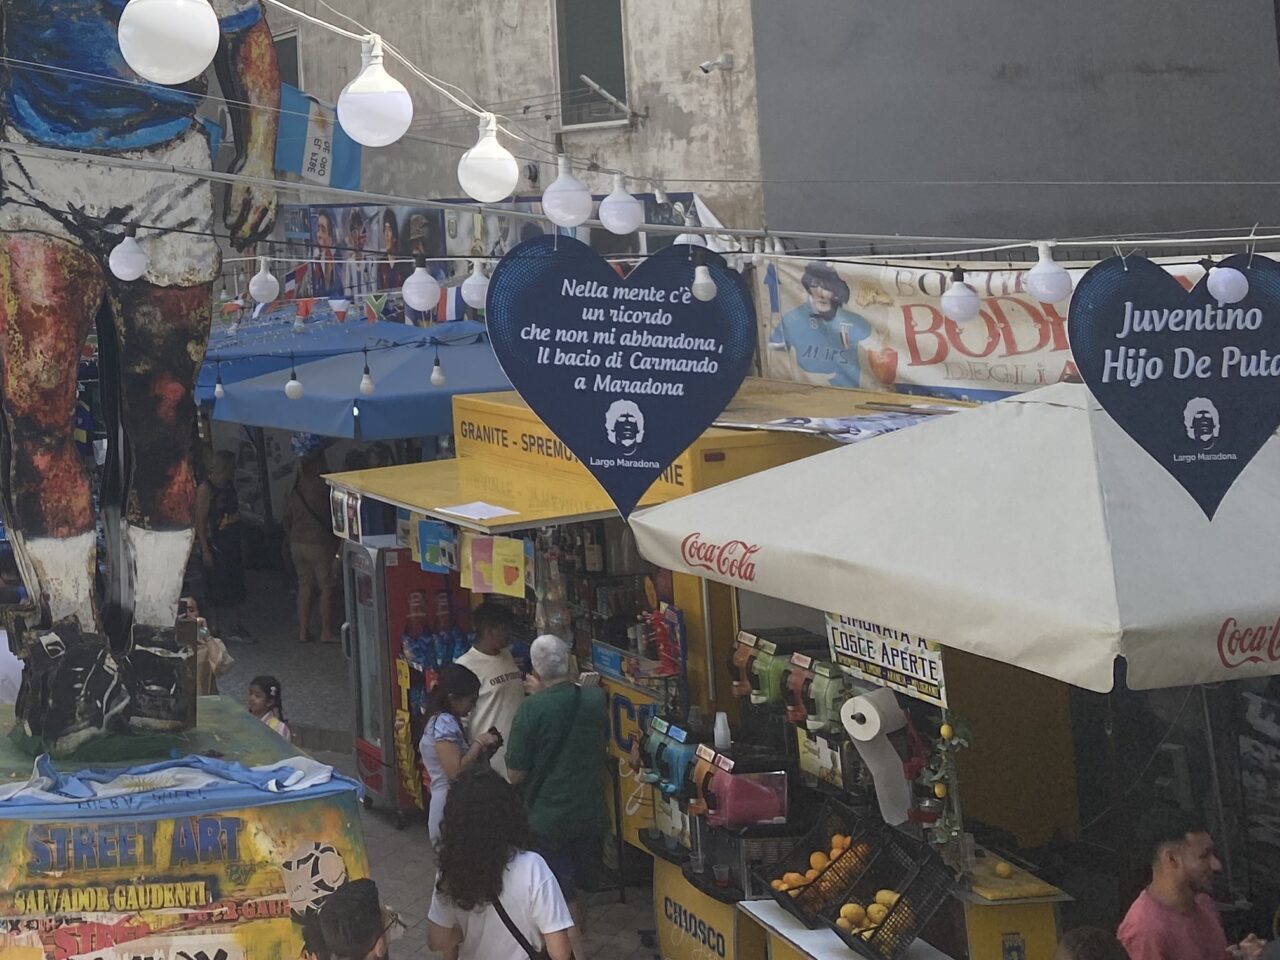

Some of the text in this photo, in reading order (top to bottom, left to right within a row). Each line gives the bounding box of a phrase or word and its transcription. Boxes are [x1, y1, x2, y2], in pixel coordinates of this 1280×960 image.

[561, 279, 608, 298] Nella
[612, 285, 664, 302] mente
[582, 306, 672, 325] un ricordo
[1116, 302, 1263, 338] Juventino
[520, 324, 550, 340] che
[555, 328, 588, 343] non
[593, 328, 615, 345] mi
[620, 330, 716, 351] abbandona
[554, 350, 600, 368] bacio
[605, 351, 623, 369] di
[629, 352, 719, 374] Carmando
[1102, 346, 1164, 387] Hijo
[1173, 347, 1212, 379] De
[574, 374, 685, 396] a Maradona
[460, 420, 509, 448] GRANITE
[521, 433, 579, 464] SPREMU
[590, 457, 660, 469] Largo Maradona
[1173, 452, 1237, 463] Largo Maradona
[831, 626, 876, 660] COSCE
[881, 642, 939, 681] APERTE
[27, 816, 242, 874] STREET ART
[15, 882, 206, 914] SALVADOR GAUDENTI
